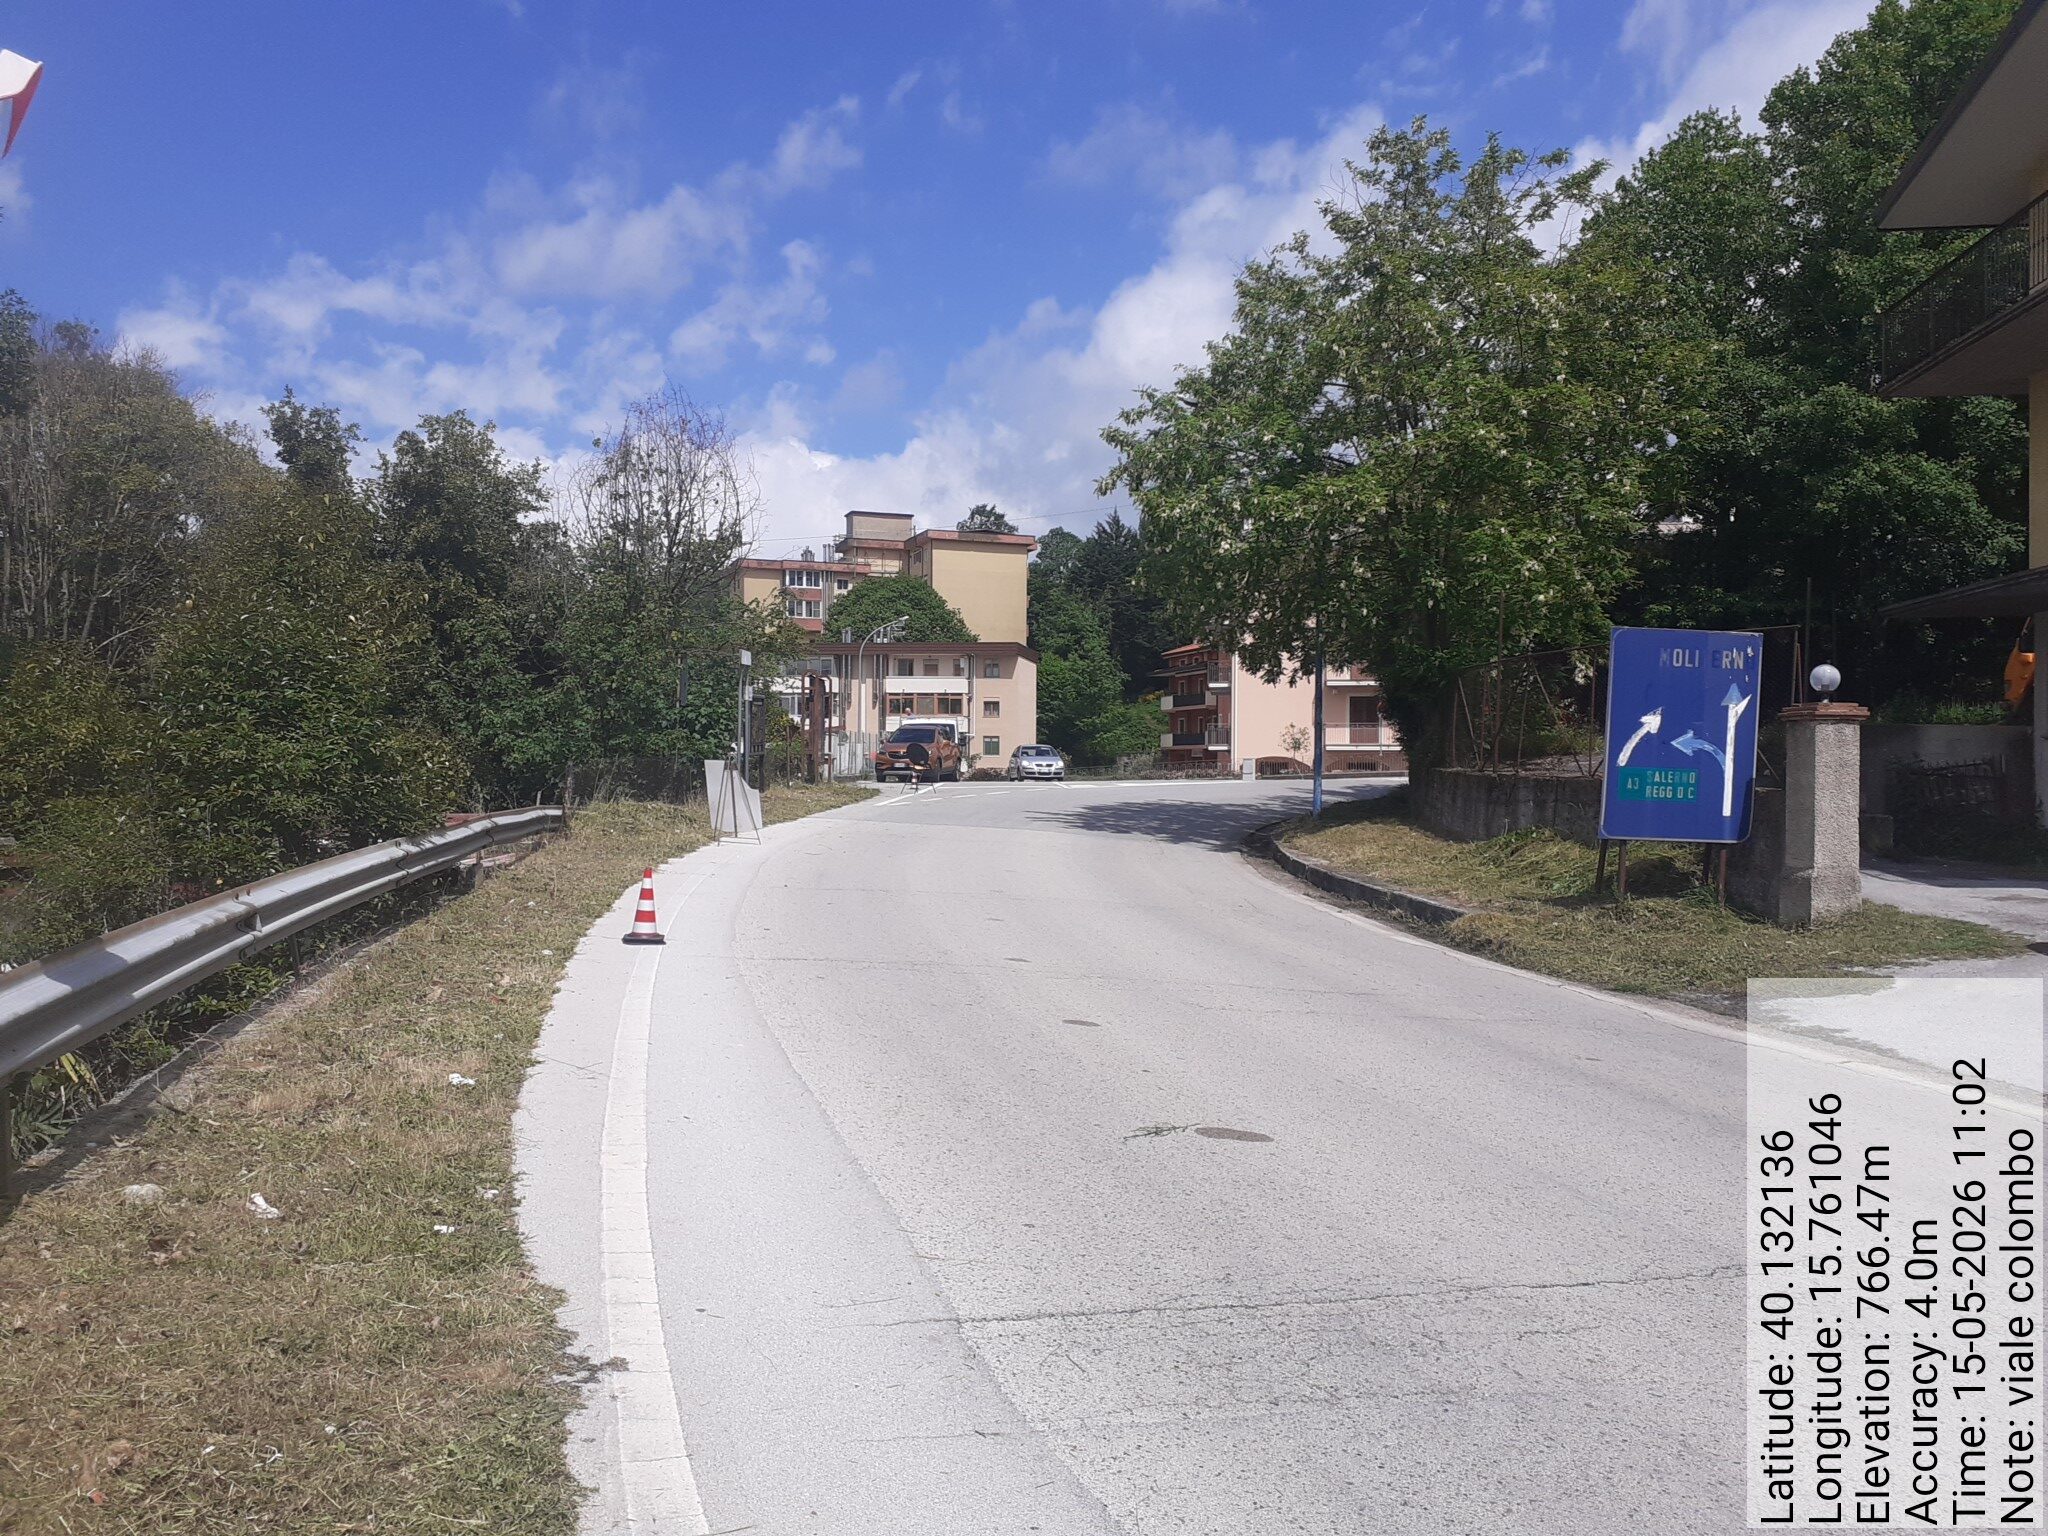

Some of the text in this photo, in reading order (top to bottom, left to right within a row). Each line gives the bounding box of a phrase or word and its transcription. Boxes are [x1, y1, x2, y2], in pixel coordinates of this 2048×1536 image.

[1627, 777, 1639, 789] A3
[1647, 771, 1696, 784] SALERNO
[1688, 787, 1695, 799] C
